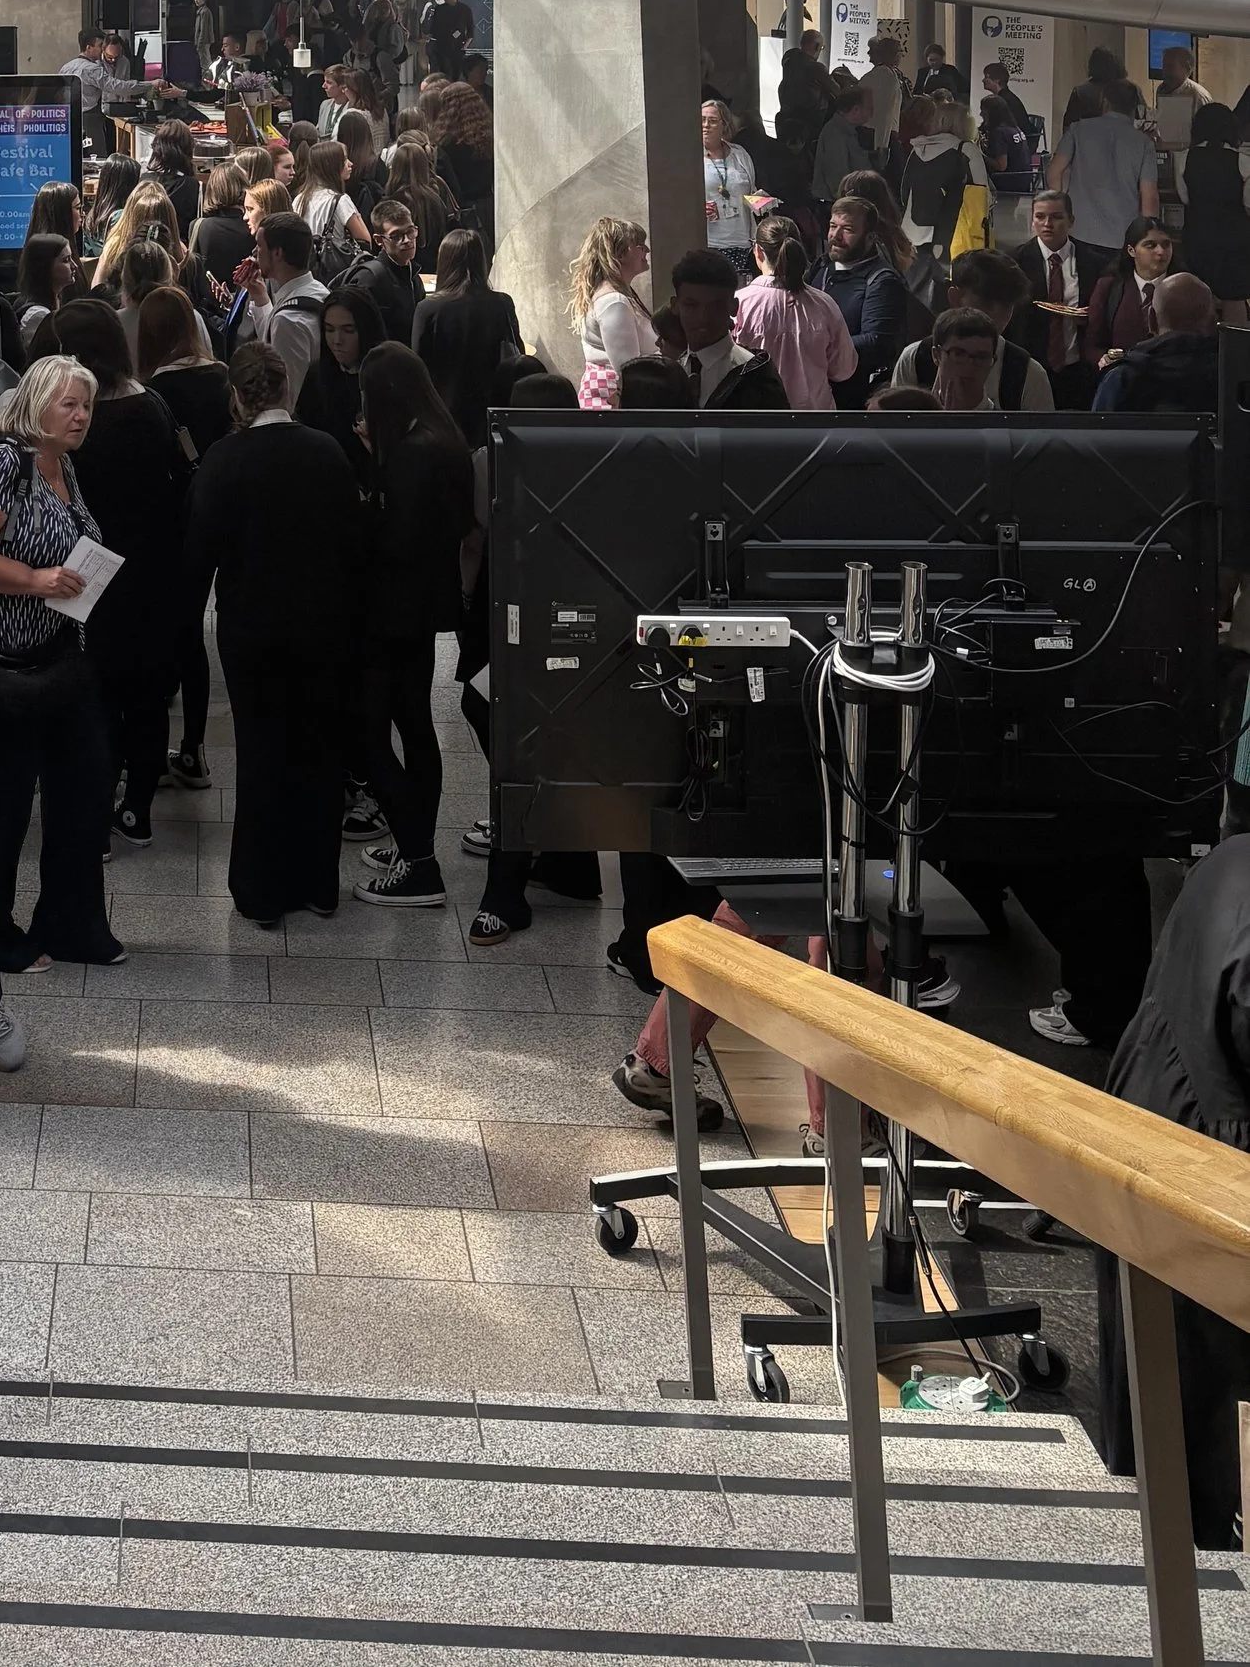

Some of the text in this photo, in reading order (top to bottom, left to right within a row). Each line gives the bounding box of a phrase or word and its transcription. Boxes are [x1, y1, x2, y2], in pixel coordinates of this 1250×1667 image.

[1006, 24, 1043, 32] PEOPLE'S
[1005, 32, 1042, 40] MEETING
[15, 110, 26, 118] OF
[31, 109, 66, 118] POLITICS
[23, 123, 66, 132] PHOILITIGS
[29, 164, 56, 177] Bar
